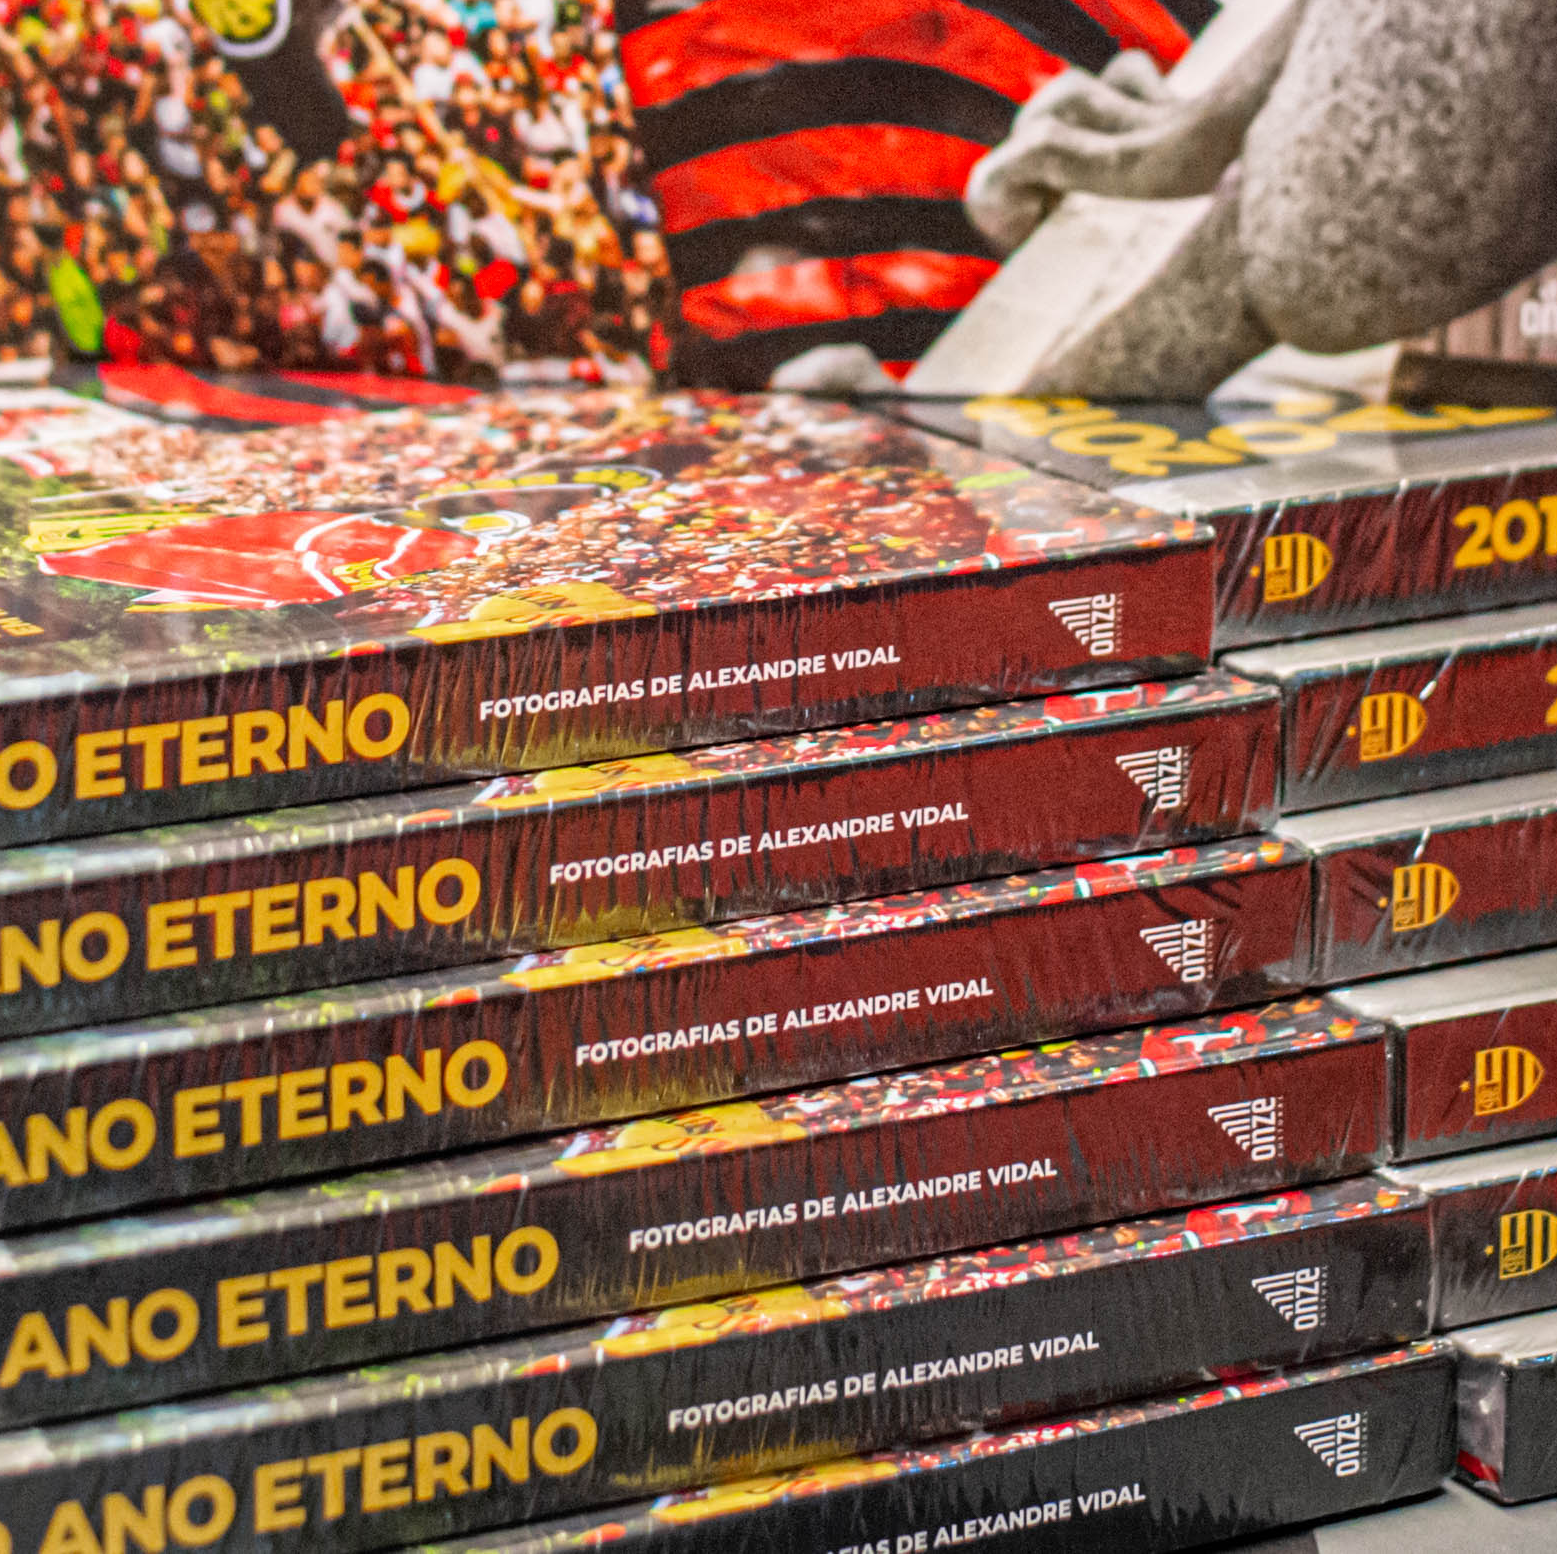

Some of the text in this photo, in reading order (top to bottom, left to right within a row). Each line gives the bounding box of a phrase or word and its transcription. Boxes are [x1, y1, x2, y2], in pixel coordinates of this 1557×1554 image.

[1090, 592, 1116, 657] onze
[479, 644, 901, 722] FOTOGRAFIAS DE ALEXANDRE VIDAL
[74, 691, 412, 801] ETERNO
[1156, 745, 1183, 810] onze
[549, 802, 969, 885] FOTOGRAFIAS DE ALEXANDRE VIDAL
[145, 857, 482, 972] ETERNO
[1181, 918, 1207, 983] onze
[575, 977, 994, 1067] FOTOGRAFIAS DE ALEXANDRE VIDAL
[173, 1039, 509, 1159] ETERNO
[1251, 1096, 1277, 1162] onze
[629, 1157, 1058, 1252] FOTOGRAFIAS DE ALEXANDRE VIDAL
[217, 1225, 560, 1348] ETERNO
[1294, 1265, 1321, 1332] onze
[668, 1330, 1100, 1432] FOTOGRAFIAS DE ALEXANDRE VIDAL
[38, 1474, 236, 1554] ANO
[253, 1407, 598, 1535] ETERNO
[1335, 1411, 1362, 1478] onze
[896, 1530, 928, 1554] DE
[933, 1498, 1072, 1548] ALEXANDRE
[1077, 1483, 1146, 1514] VIDAL
